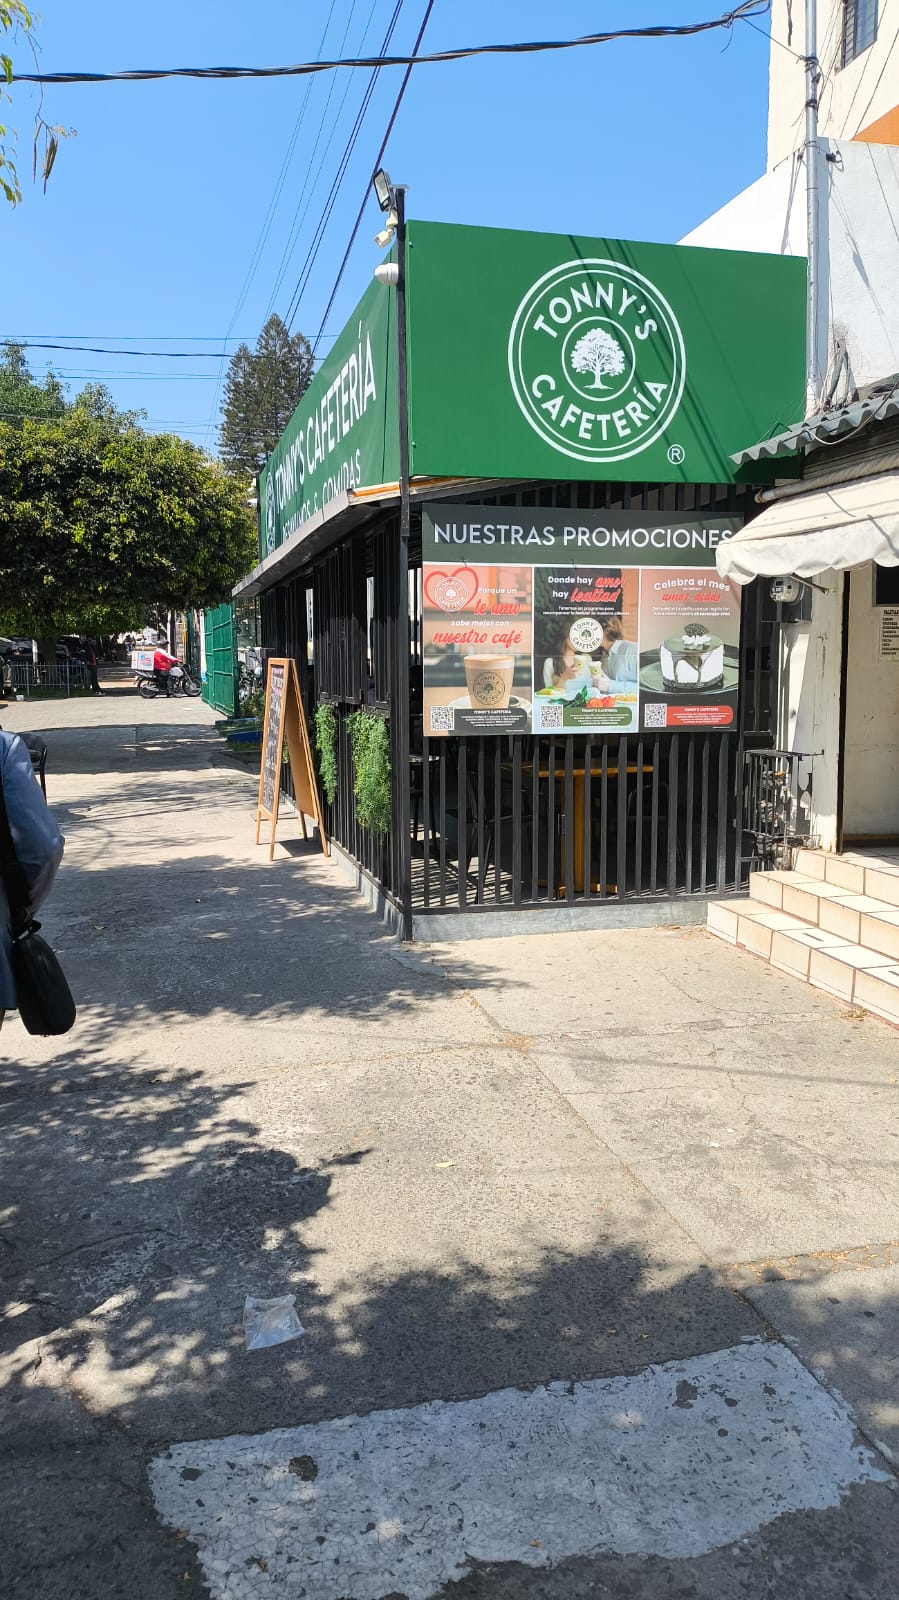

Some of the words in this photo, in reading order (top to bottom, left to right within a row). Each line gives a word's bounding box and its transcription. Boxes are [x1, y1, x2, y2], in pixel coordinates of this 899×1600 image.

[533, 281, 657, 340] TONNY'S
[532, 374, 668, 440] CAFETERÍA
[275, 430, 305, 514] TONNY'S
[306, 319, 377, 475] CAFETERÍA
[434, 523, 555, 546] NUESTRAS
[548, 576, 575, 584] Donde
[577, 576, 593, 586] hay
[654, 578, 695, 591] Celebra
[697, 578, 707, 587] el
[709, 580, 730, 592] mes
[478, 587, 505, 595] Porque
[553, 590, 569, 600] hay
[570, 588, 621, 603] lealtad
[474, 599, 487, 616] te
[491, 603, 521, 616] amo
[471, 620, 493, 628] mejor
[574, 621, 599, 632] TONNY'S
[432, 629, 488, 644] nuestro
[492, 629, 523, 649] café
